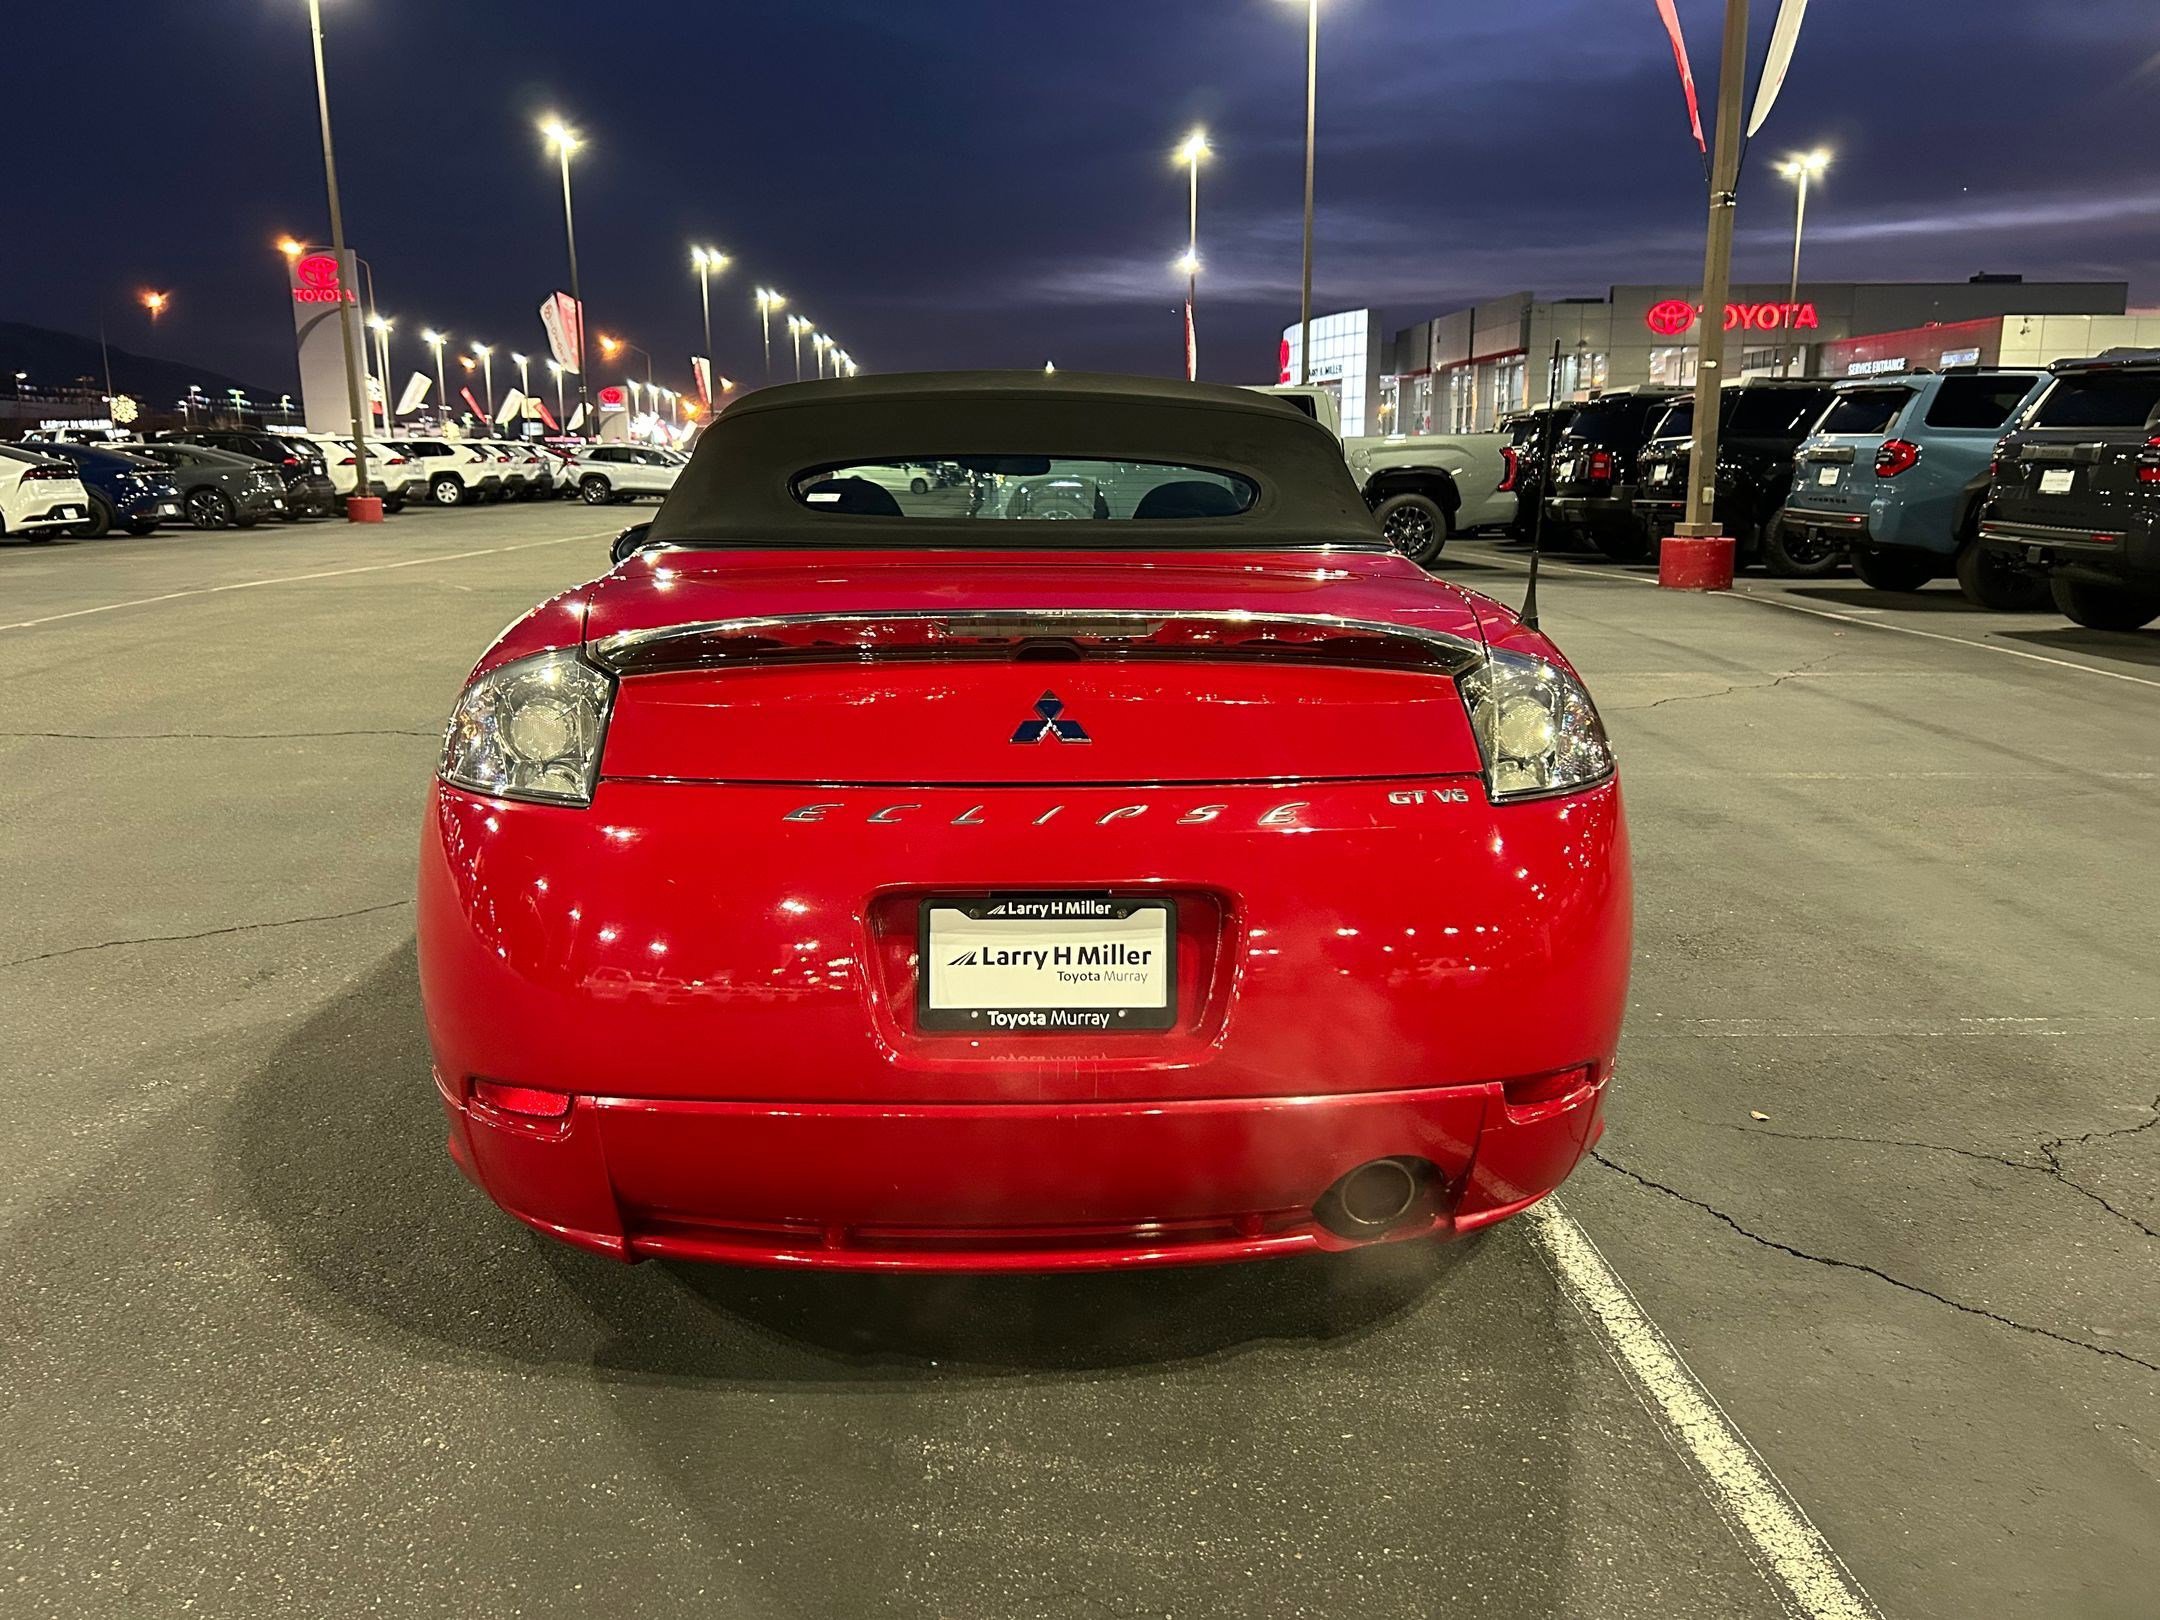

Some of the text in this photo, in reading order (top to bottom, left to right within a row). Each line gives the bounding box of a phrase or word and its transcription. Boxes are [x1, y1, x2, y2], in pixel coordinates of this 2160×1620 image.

[1697, 303, 1819, 330] OYOTA
[1848, 357, 1905, 376] SERVICE ENTRANCE
[1388, 788, 1469, 805] GT V6
[782, 802, 1311, 826] ECLIPSE
[1008, 900, 1112, 918] Larry H Miller
[982, 943, 1152, 970] Larry H Miller
[1057, 970, 1149, 984] Toyota Murray
[987, 1010, 1110, 1029] Toyota Murray
